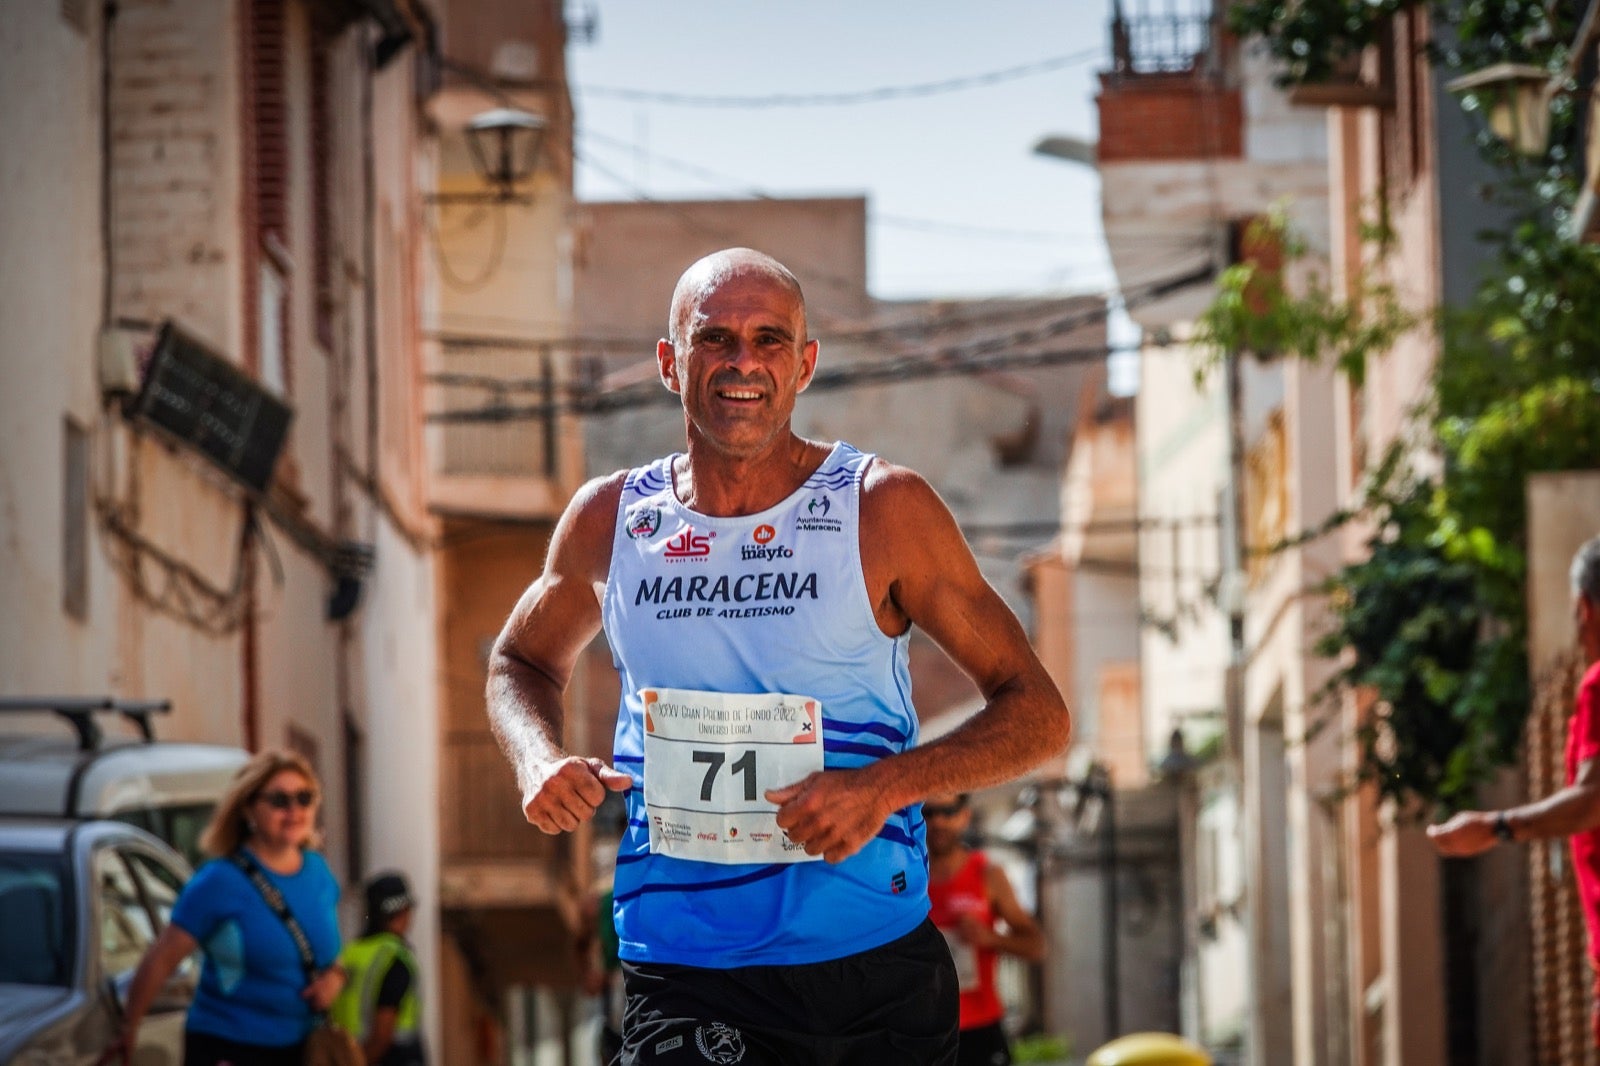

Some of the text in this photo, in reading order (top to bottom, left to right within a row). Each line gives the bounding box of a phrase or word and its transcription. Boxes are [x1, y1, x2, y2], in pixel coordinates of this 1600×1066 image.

[796, 516, 842, 525] Ayuntamiento
[803, 524, 841, 532] Maracena
[741, 545, 794, 562] mayfo
[635, 572, 819, 606] MARACENA
[656, 605, 796, 620] CLUB DE ATLETISMO
[773, 706, 796, 721] 2022
[692, 750, 757, 802] 71
